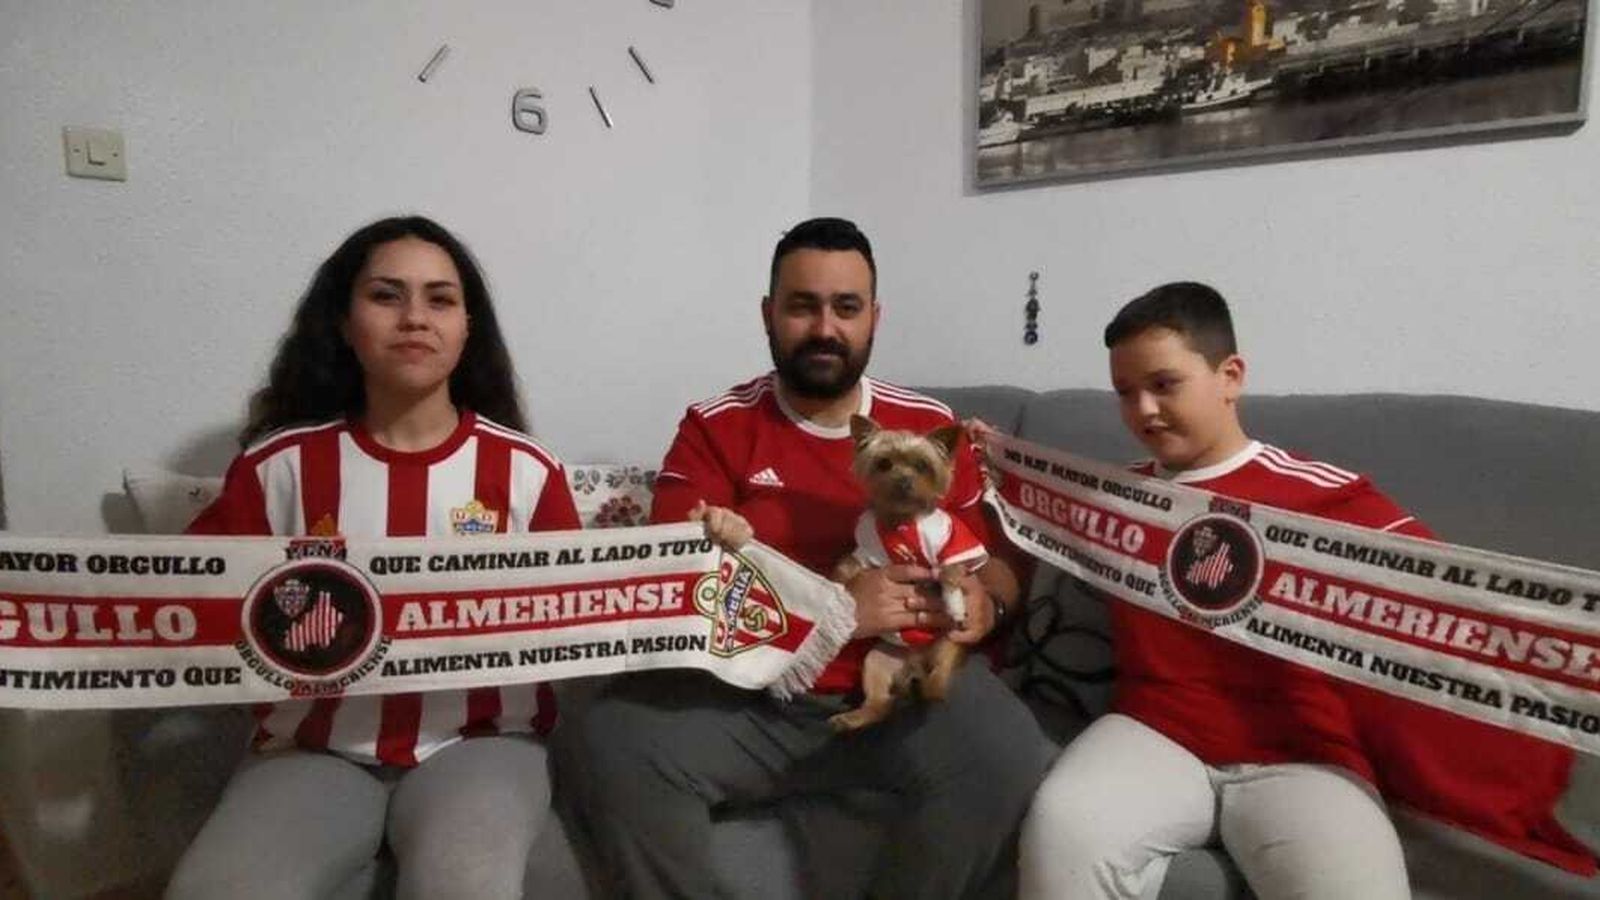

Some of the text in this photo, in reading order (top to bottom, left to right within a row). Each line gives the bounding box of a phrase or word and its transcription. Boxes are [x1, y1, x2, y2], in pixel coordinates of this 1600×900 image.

[511, 87, 548, 135] 6
[1051, 463, 1099, 491] MAYOR
[1102, 480, 1173, 512] ORGULLO
[1020, 482, 1145, 553] ORGULLO
[86, 552, 226, 576] ORGULLO
[370, 538, 713, 575] QUE CAMINAR AL LADO TUYO
[1265, 524, 1309, 549] QUE
[1312, 536, 1437, 579] CAMINAR
[1442, 565, 1477, 588] AL
[1486, 573, 1573, 606] LADO
[396, 581, 685, 631] ALMERIENSE
[1125, 572, 1158, 597] QUE
[1268, 571, 1600, 682] ALMERIENSE
[183, 667, 242, 687] QUE
[380, 634, 707, 677] ALIMENTA NUESTRA PASION
[1246, 617, 1600, 735] ALIMENTA NUESTRA PASIO
